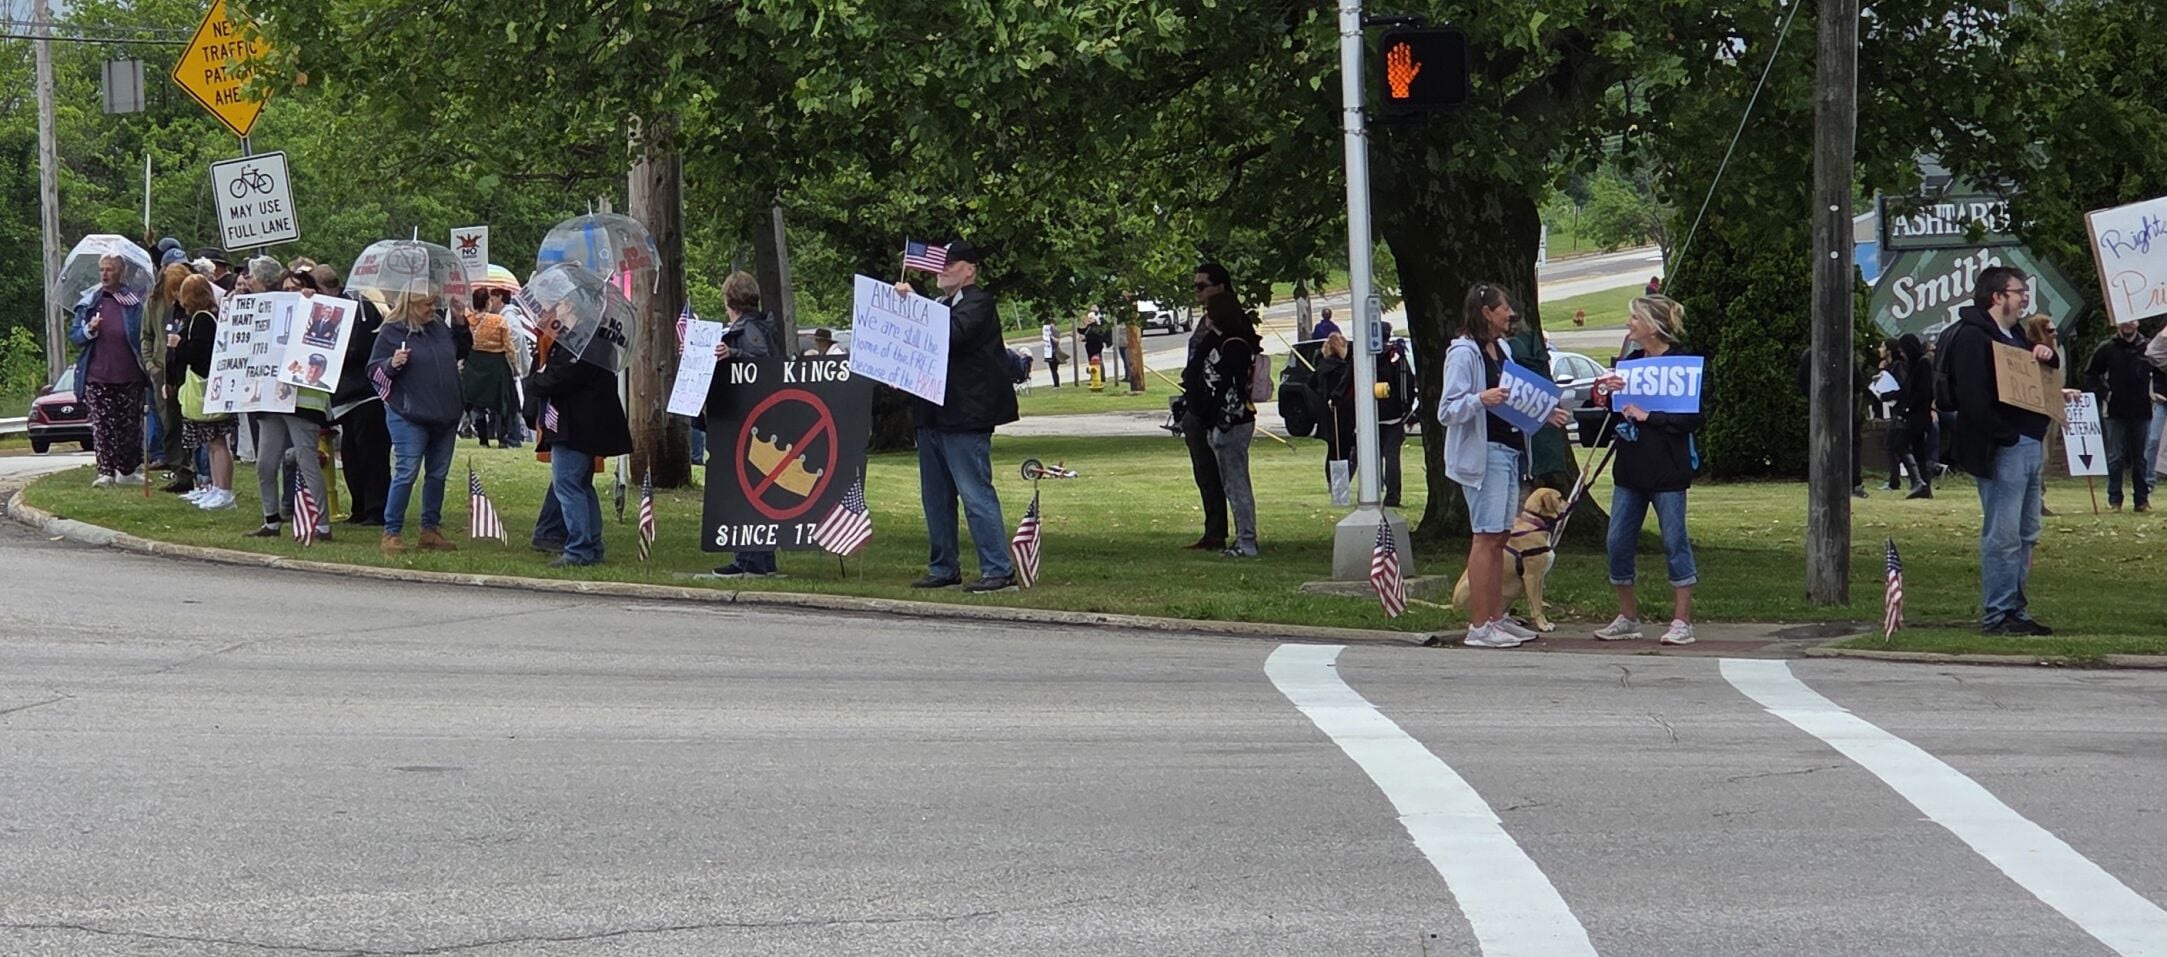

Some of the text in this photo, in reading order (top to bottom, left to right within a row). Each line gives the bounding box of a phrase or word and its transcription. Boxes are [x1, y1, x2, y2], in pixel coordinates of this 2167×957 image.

[202, 41, 257, 62] TRAFFIC
[215, 86, 242, 106] AHE
[230, 199, 282, 220] MAY USE
[1892, 200, 2012, 237] ASHTABU
[228, 217, 291, 240] FULL LANE
[462, 248, 477, 256] NO
[236, 297, 256, 310] THEY
[519, 286, 546, 319] HANDS
[870, 282, 929, 327] AMERICA
[231, 313, 254, 327] WANT
[608, 317, 622, 332] NO
[855, 304, 878, 330] We
[880, 320, 901, 339] are
[924, 332, 940, 355] the
[231, 332, 251, 344] 1939
[853, 328, 938, 377] home of the FREE
[216, 357, 249, 371] GERMANY
[246, 365, 279, 377] FRANCE
[730, 362, 758, 384] NO
[851, 352, 887, 381] because
[887, 366, 899, 383] of
[899, 369, 914, 390] the
[1614, 364, 1702, 397] RESIST
[1499, 371, 1560, 424] RESIST
[2066, 407, 2084, 421] OFF
[795, 522, 817, 546] 17
